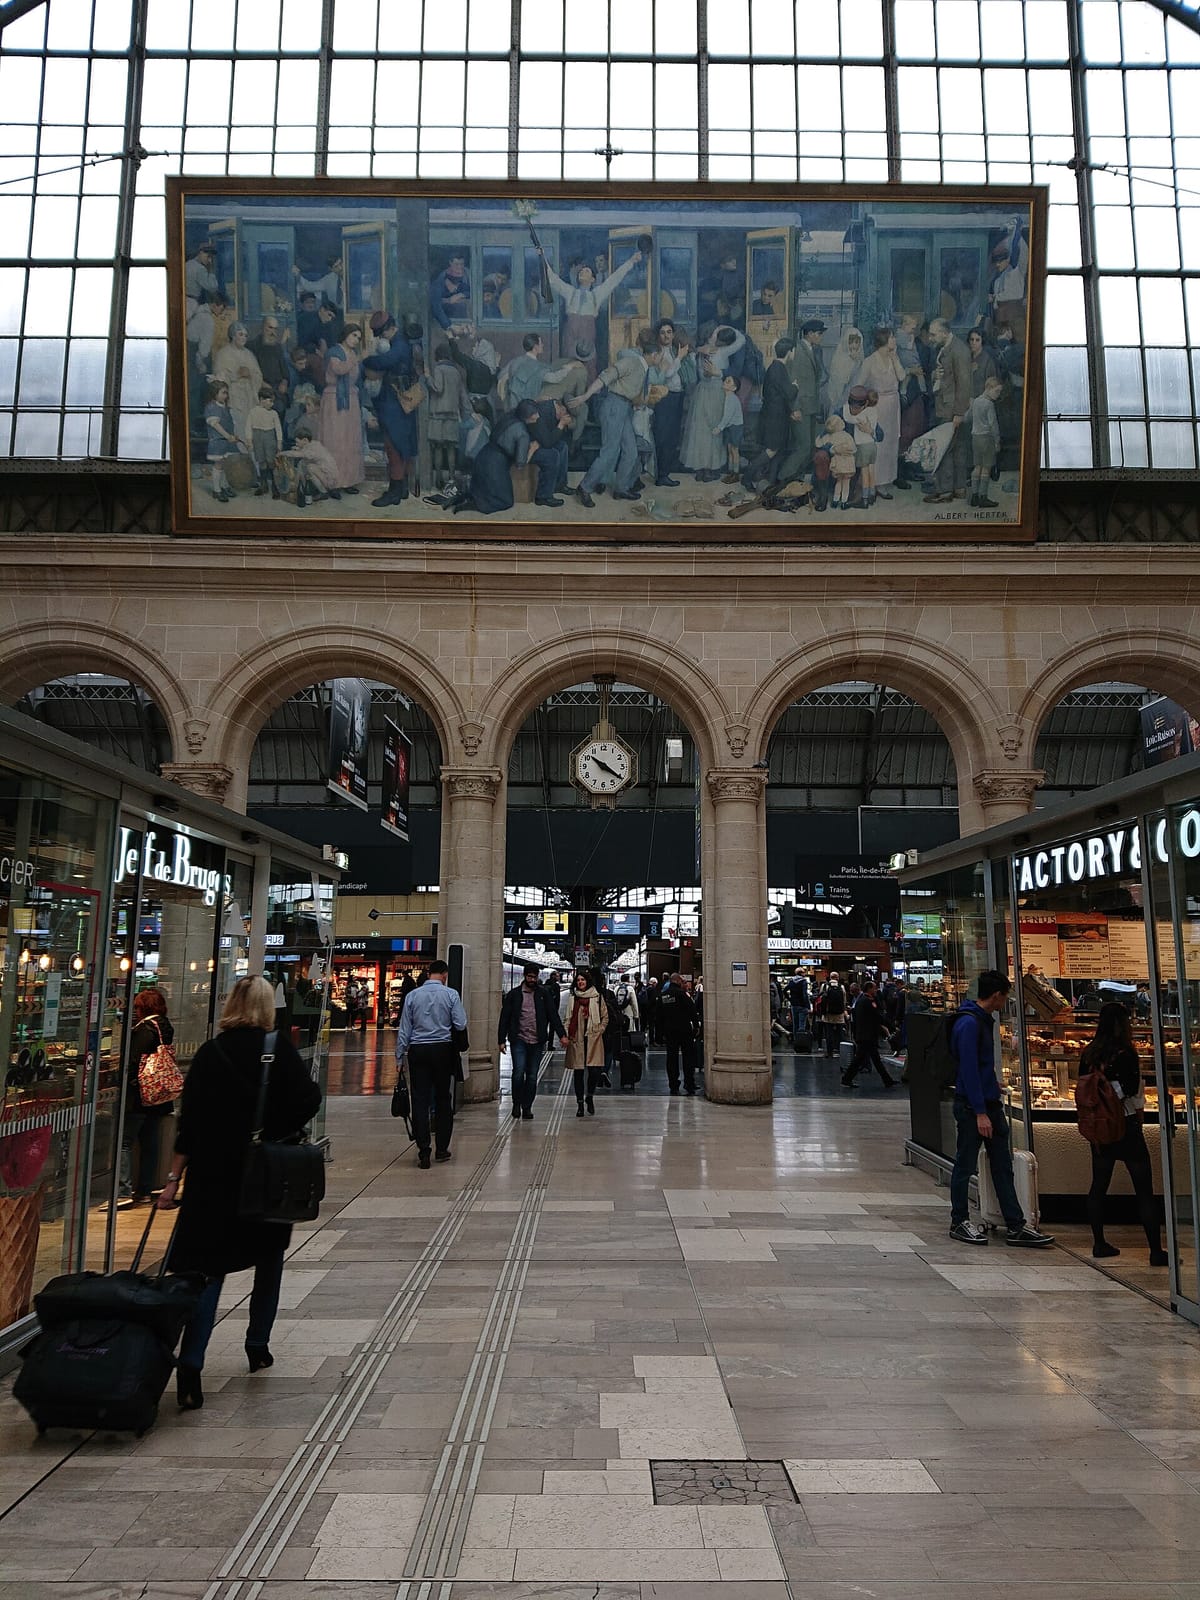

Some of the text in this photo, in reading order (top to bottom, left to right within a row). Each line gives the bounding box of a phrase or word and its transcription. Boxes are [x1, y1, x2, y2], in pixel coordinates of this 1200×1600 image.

[934, 511, 1008, 520] ALBERT HERTER
[114, 827, 157, 883] Jef
[154, 850, 172, 882] de
[859, 865, 891, 874] Île-de-Fra
[338, 882, 368, 891] andicapé
[829, 886, 850, 894] Trains
[507, 924, 515, 933] 7
[650, 925, 657, 935] 8
[883, 928, 890, 937] 9
[768, 939, 832, 949] WILD COFFEE
